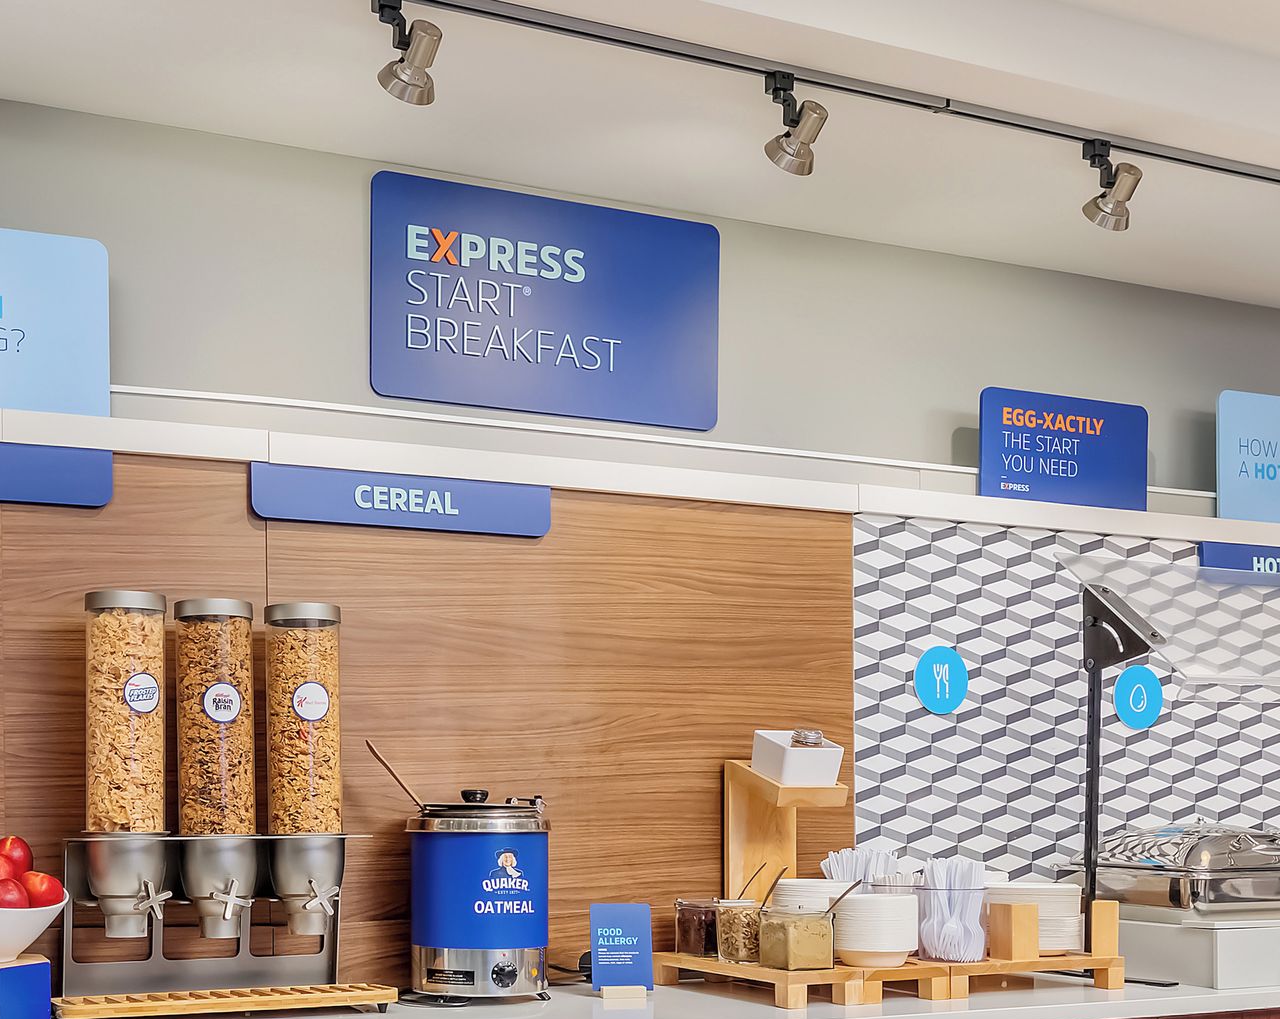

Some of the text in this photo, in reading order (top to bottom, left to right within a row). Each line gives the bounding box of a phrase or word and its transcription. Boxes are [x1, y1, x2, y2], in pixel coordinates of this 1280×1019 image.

[406, 223, 586, 283] EXPRESS
[406, 313, 622, 373] BREAKFAST
[1002, 407, 1105, 436] EGG-XACTLY
[1002, 431, 1080, 456] THE START
[1238, 437, 1278, 459] HOW
[1001, 453, 1078, 478] YOU NEED
[1238, 460, 1250, 479] A
[1000, 482, 1030, 492] EXPRESS
[353, 484, 459, 516] CEREAL
[212, 697, 234, 706] Raisin
[215, 703, 232, 711] Bran
[482, 877, 530, 892] QUAKER
[474, 900, 535, 914] OATMEAL
[598, 928, 623, 936] FOOD
[598, 937, 639, 945] ALLERGY
